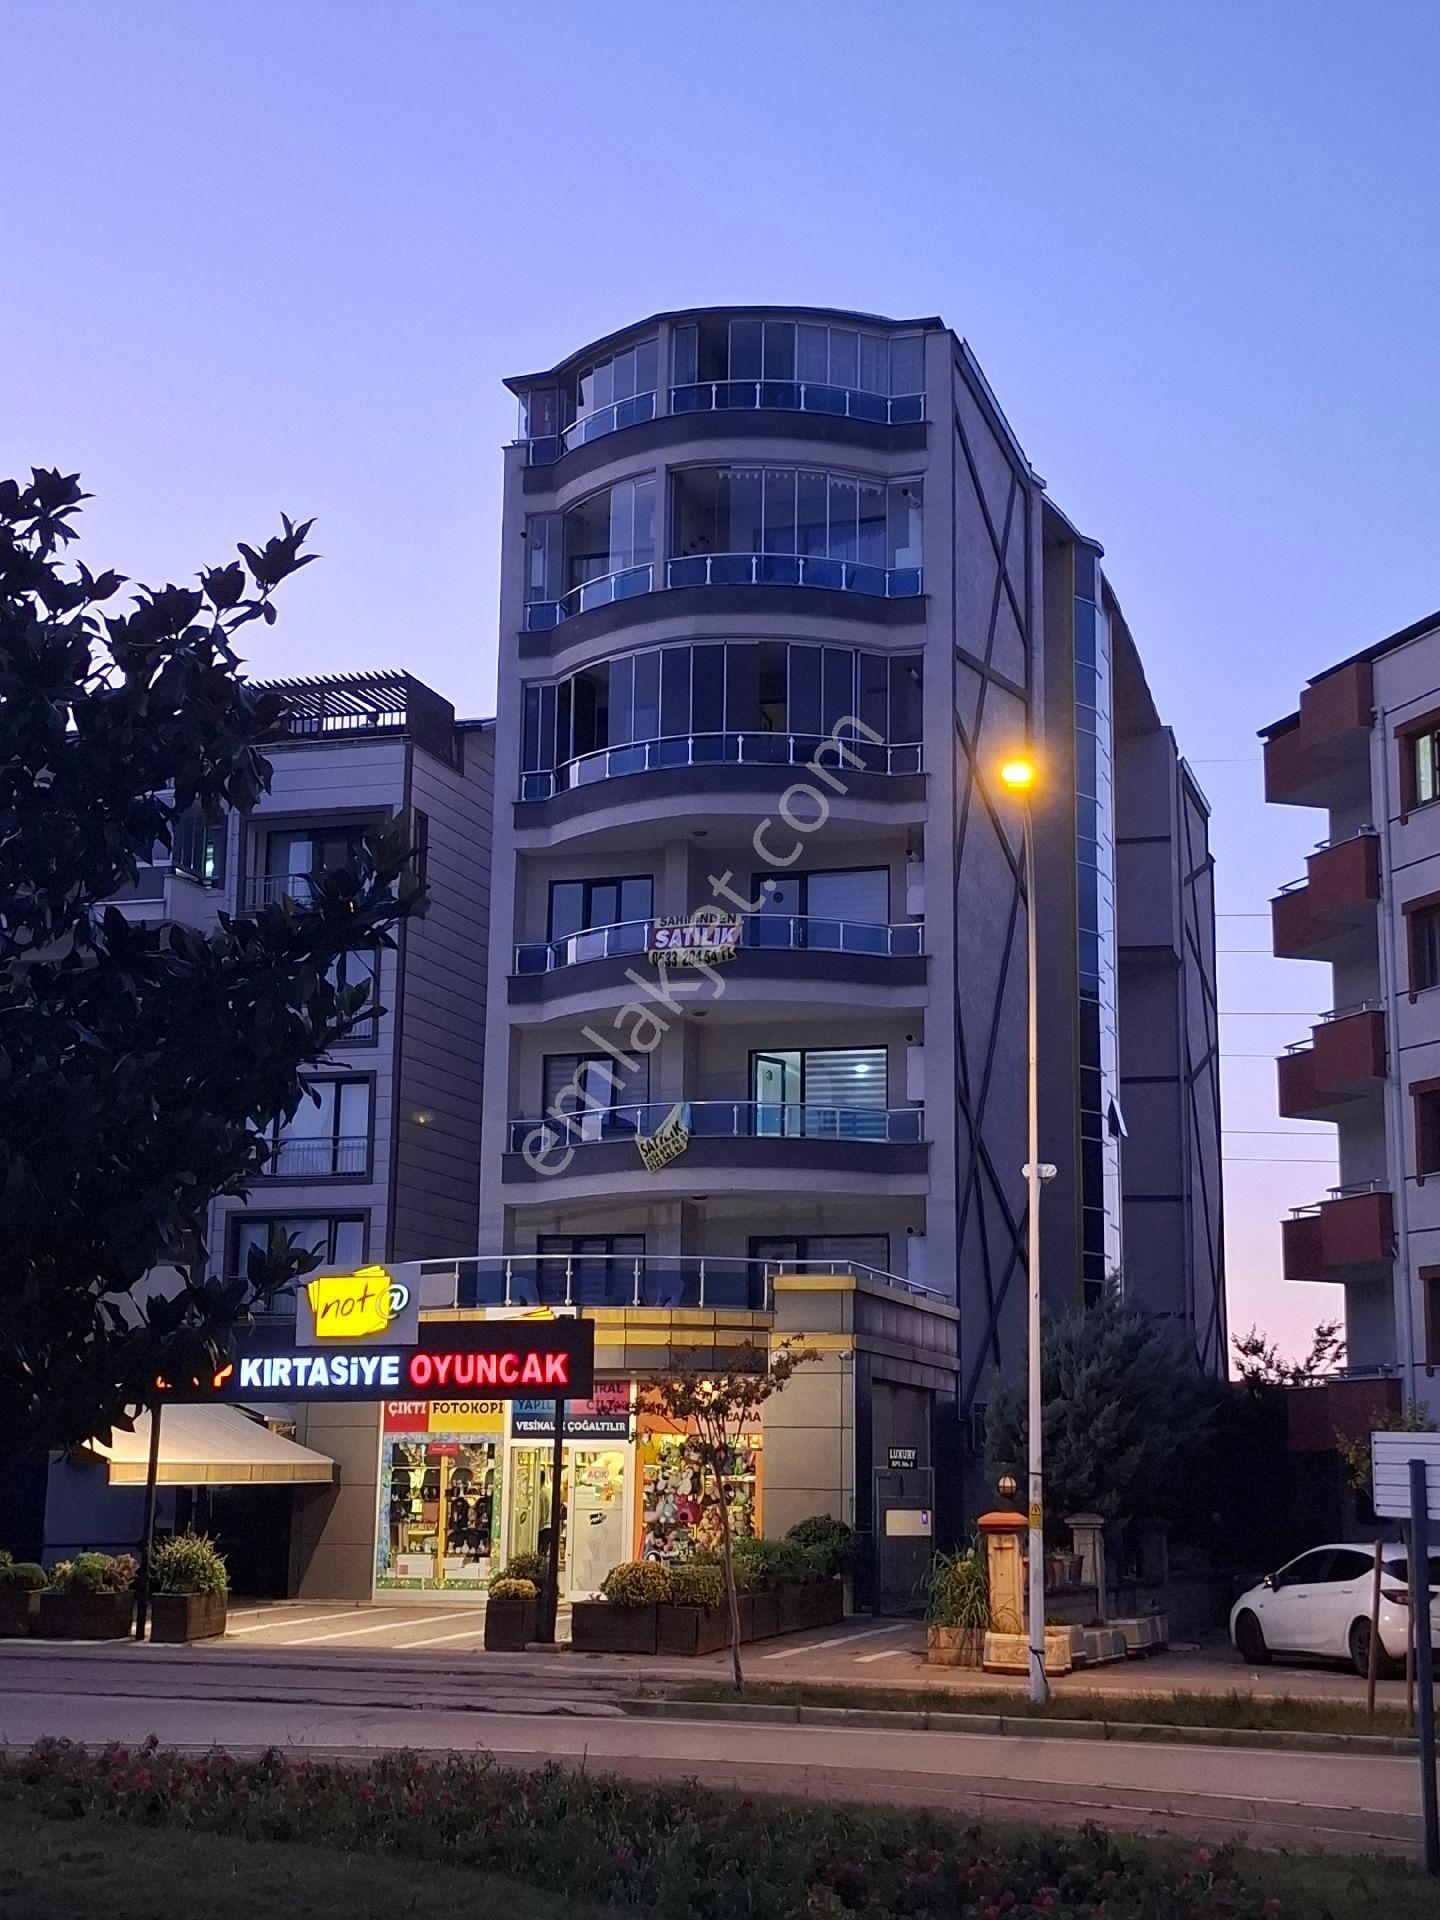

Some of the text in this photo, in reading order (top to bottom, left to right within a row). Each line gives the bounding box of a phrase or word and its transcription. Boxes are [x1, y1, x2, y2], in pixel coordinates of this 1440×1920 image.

[655, 927, 736, 948] SATILIK
[409, 1353, 569, 1386] OYUNCAK
[388, 1401, 427, 1417] ÇIKTI
[889, 1448, 916, 1460] LUXURY
